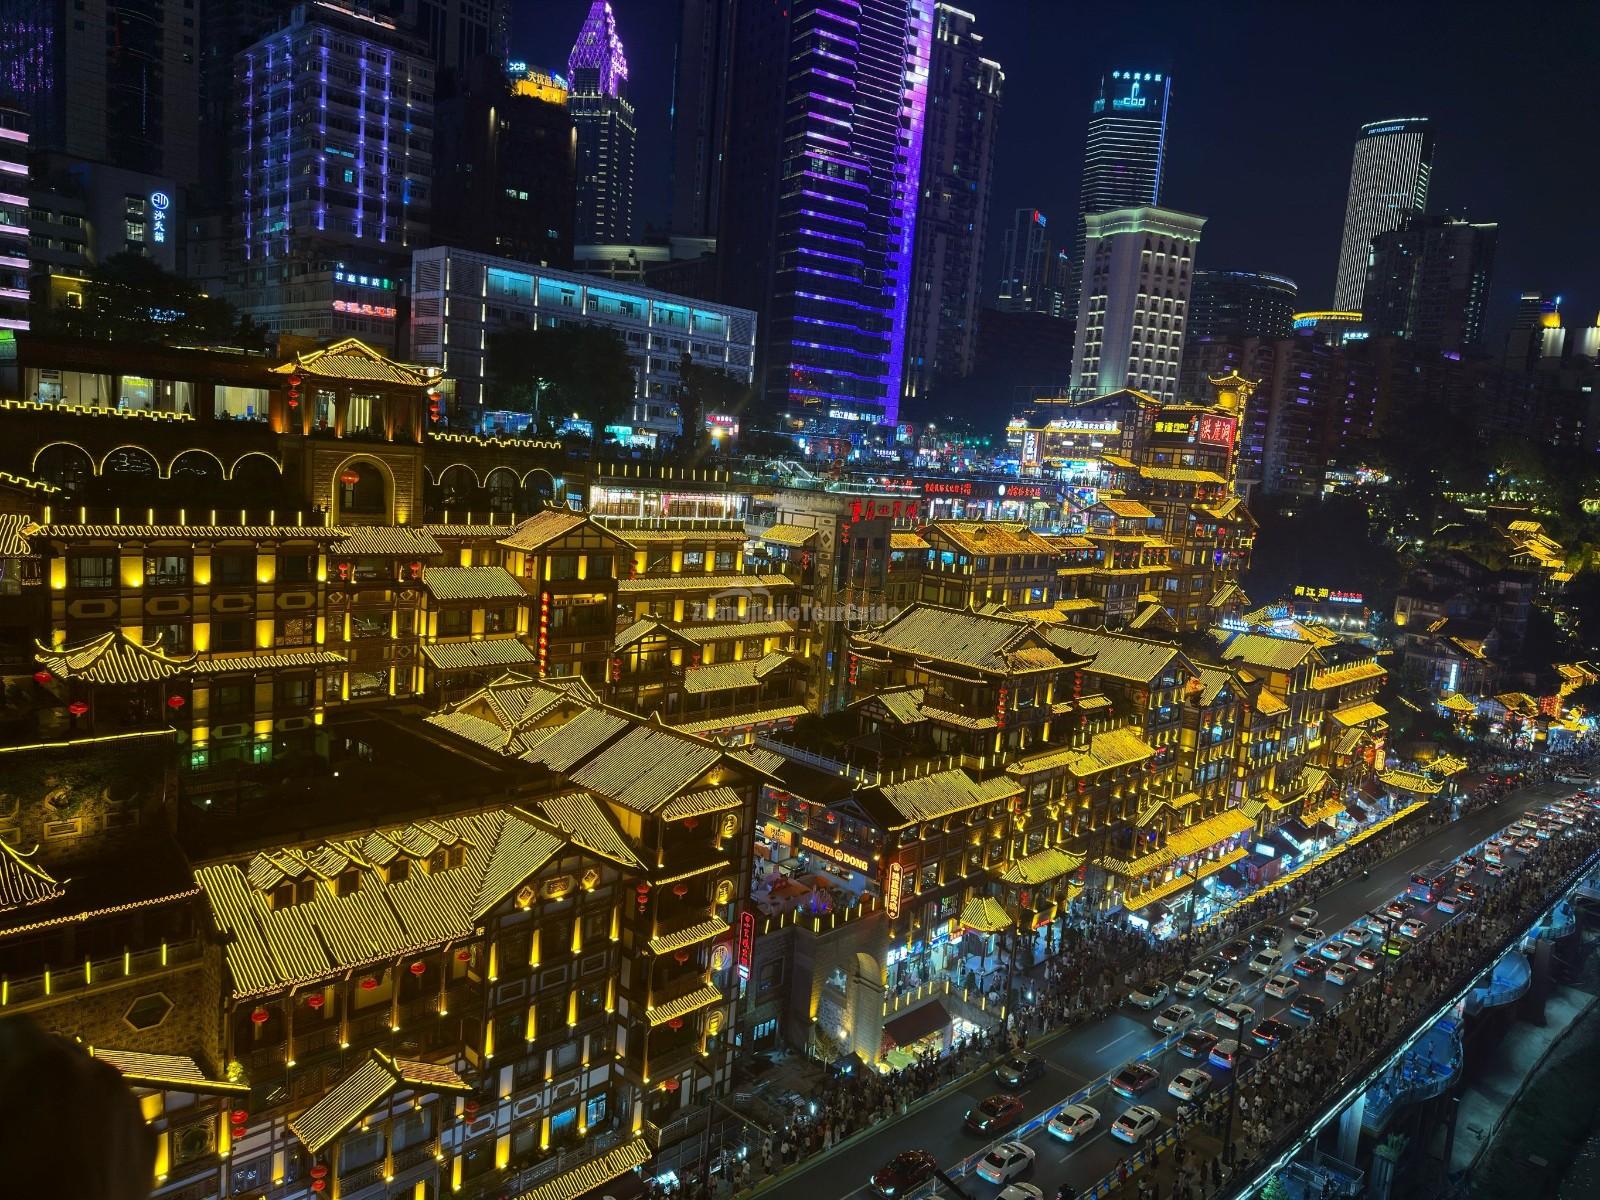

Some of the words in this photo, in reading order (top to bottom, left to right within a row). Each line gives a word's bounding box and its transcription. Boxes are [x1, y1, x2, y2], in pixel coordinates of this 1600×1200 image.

[1112, 71, 1162, 82] 中央商务区
[1201, 417, 1231, 444] 洪崖洞
[801, 836, 835, 858] HONGYA
[843, 853, 868, 872] DONG
